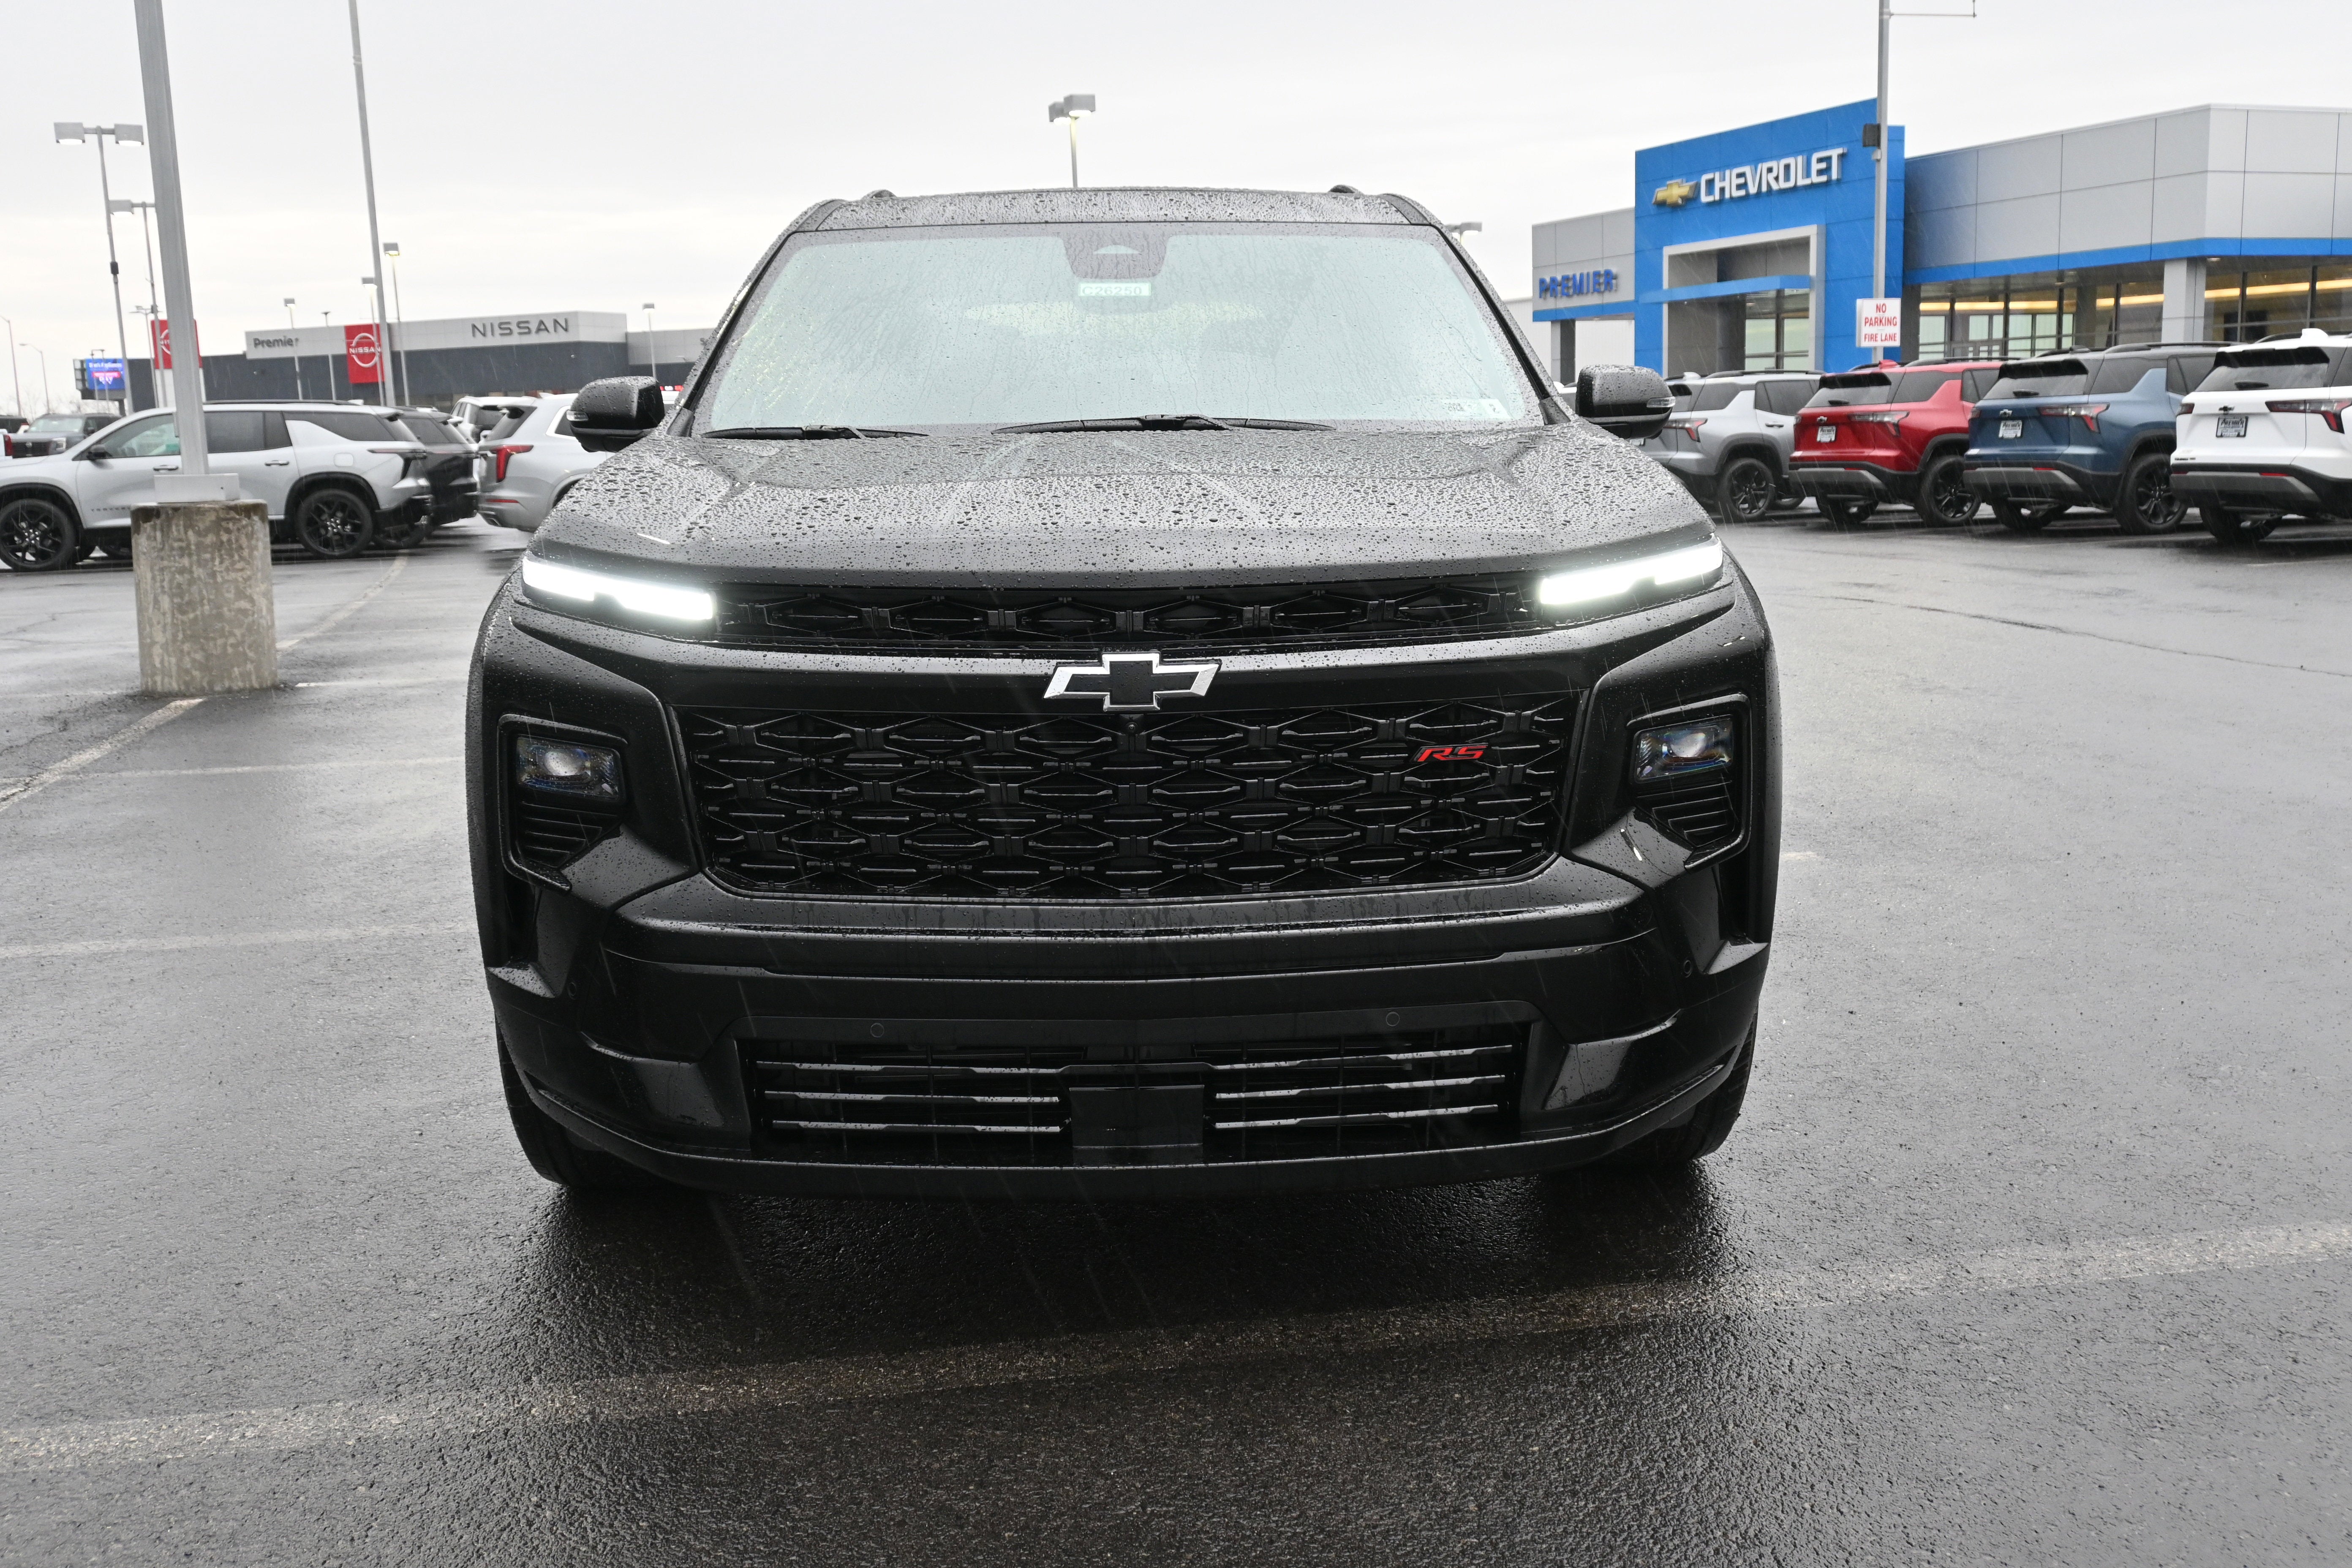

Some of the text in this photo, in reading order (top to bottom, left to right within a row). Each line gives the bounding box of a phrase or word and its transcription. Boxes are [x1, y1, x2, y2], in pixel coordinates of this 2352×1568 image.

[1700, 147, 1844, 204] CHEVROLET
[1538, 268, 1615, 299] PREMIER
[1082, 286, 1143, 296] C26250
[1876, 302, 1887, 313] NO
[471, 317, 569, 338] NISSAN
[1864, 316, 1897, 327] PARKING
[253, 335, 299, 349] Premier
[1864, 332, 1897, 342] FIRE LANE
[349, 346, 381, 354] NISSAN
[1416, 745, 1488, 762] RS
